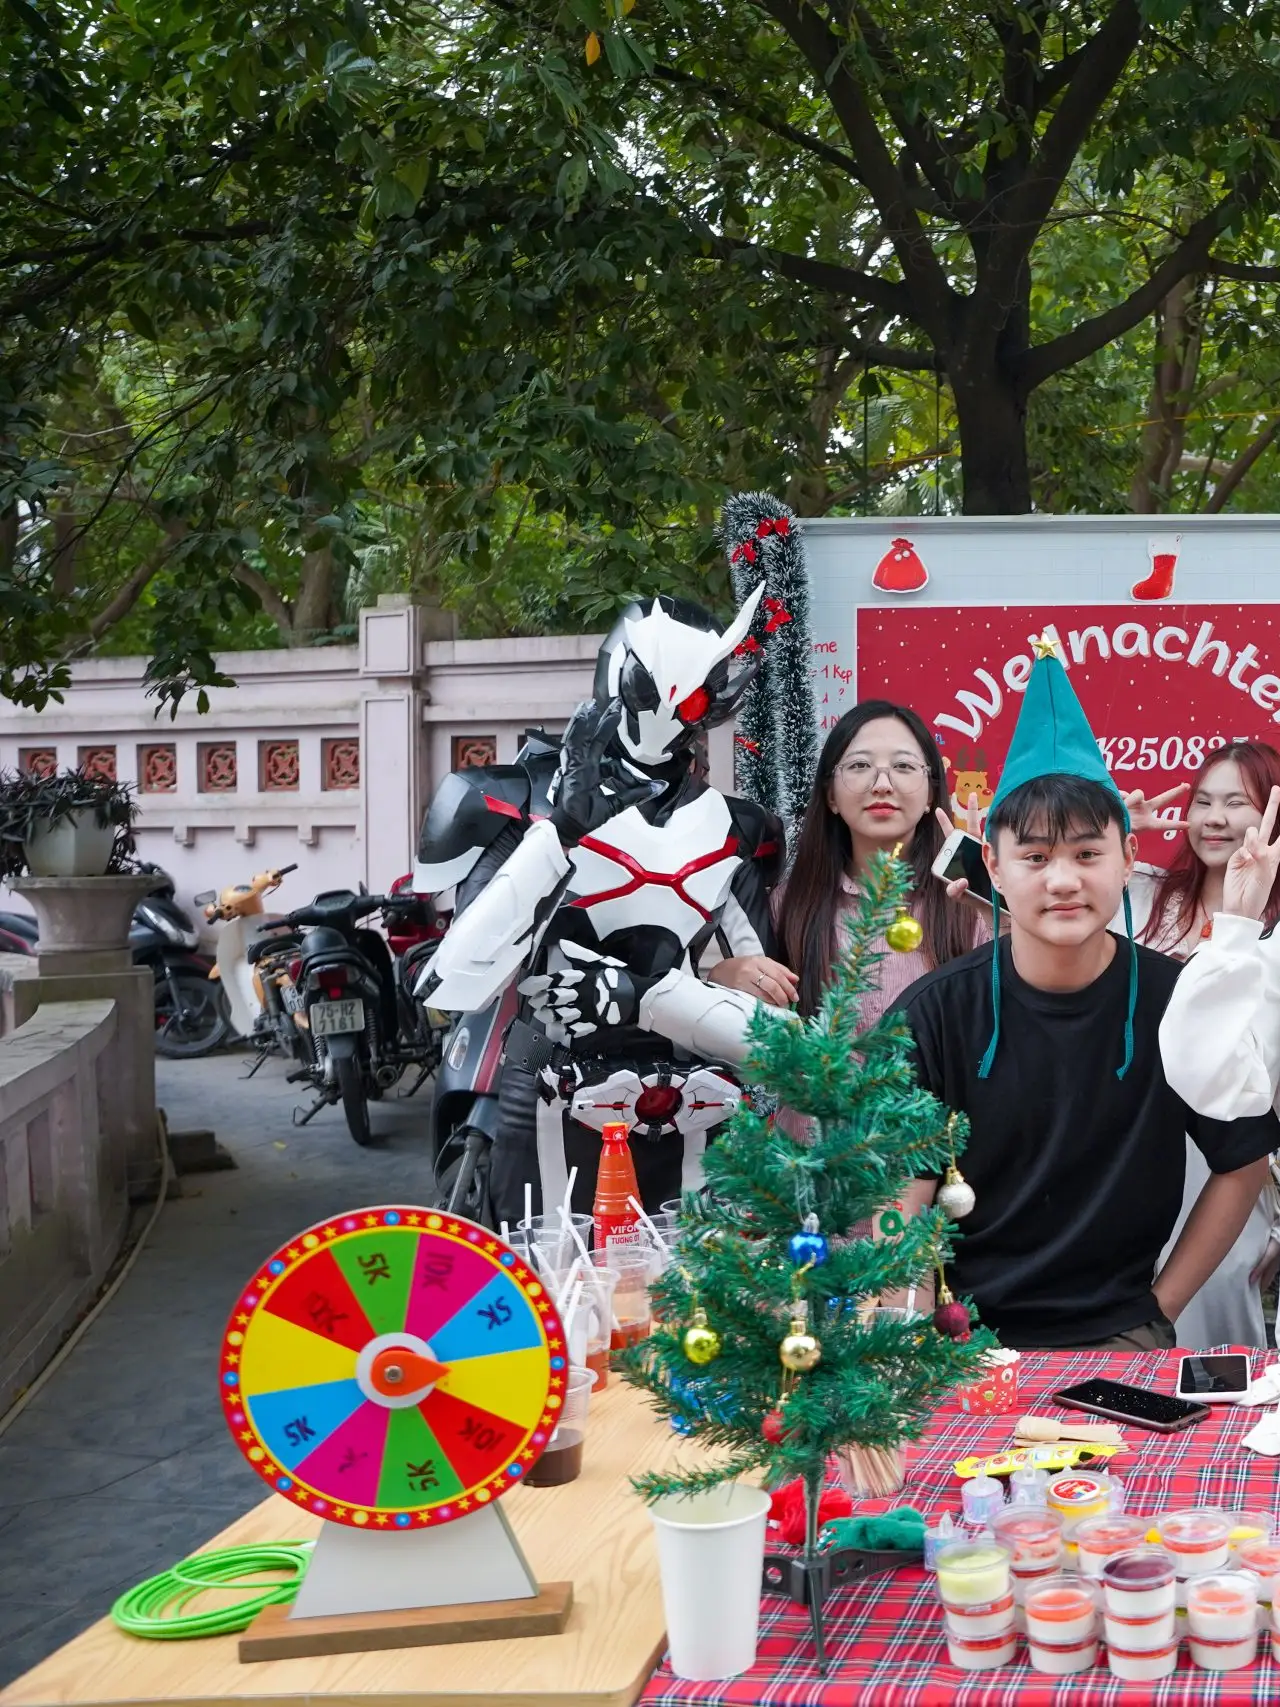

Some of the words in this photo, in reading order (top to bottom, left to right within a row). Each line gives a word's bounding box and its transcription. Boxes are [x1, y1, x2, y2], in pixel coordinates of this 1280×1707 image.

[1096, 735, 1248, 771] K2508
[357, 1253, 391, 1286] 5K
[421, 1251, 455, 1292] 10K
[477, 1295, 513, 1330] 5K
[283, 1416, 316, 1447] 5K
[457, 1416, 506, 1453] 10K
[405, 1459, 440, 1491] 5K
